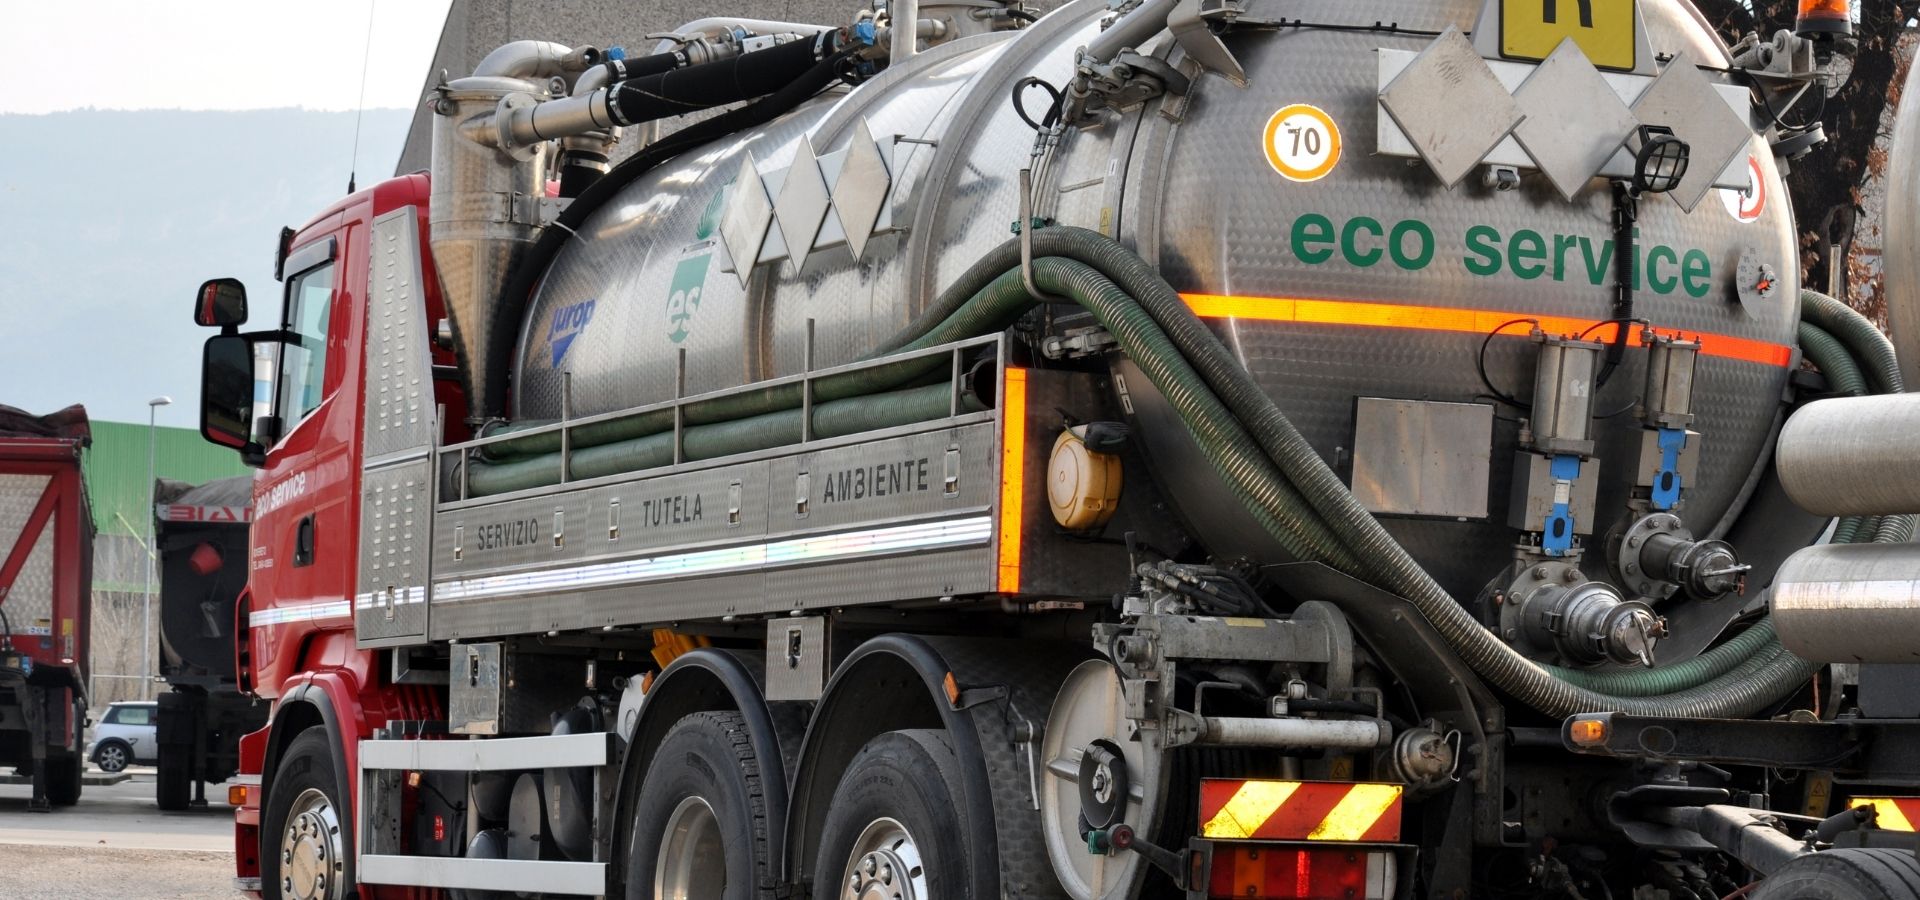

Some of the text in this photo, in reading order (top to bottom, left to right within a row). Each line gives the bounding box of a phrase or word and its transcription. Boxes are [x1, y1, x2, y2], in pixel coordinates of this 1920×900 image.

[1288, 127, 1321, 157] 70
[1290, 213, 1435, 270] eco
[1463, 224, 1712, 298] service
[271, 469, 306, 510] service
[477, 457, 928, 550] SERVIZIO TUTELA AMBIENTE
